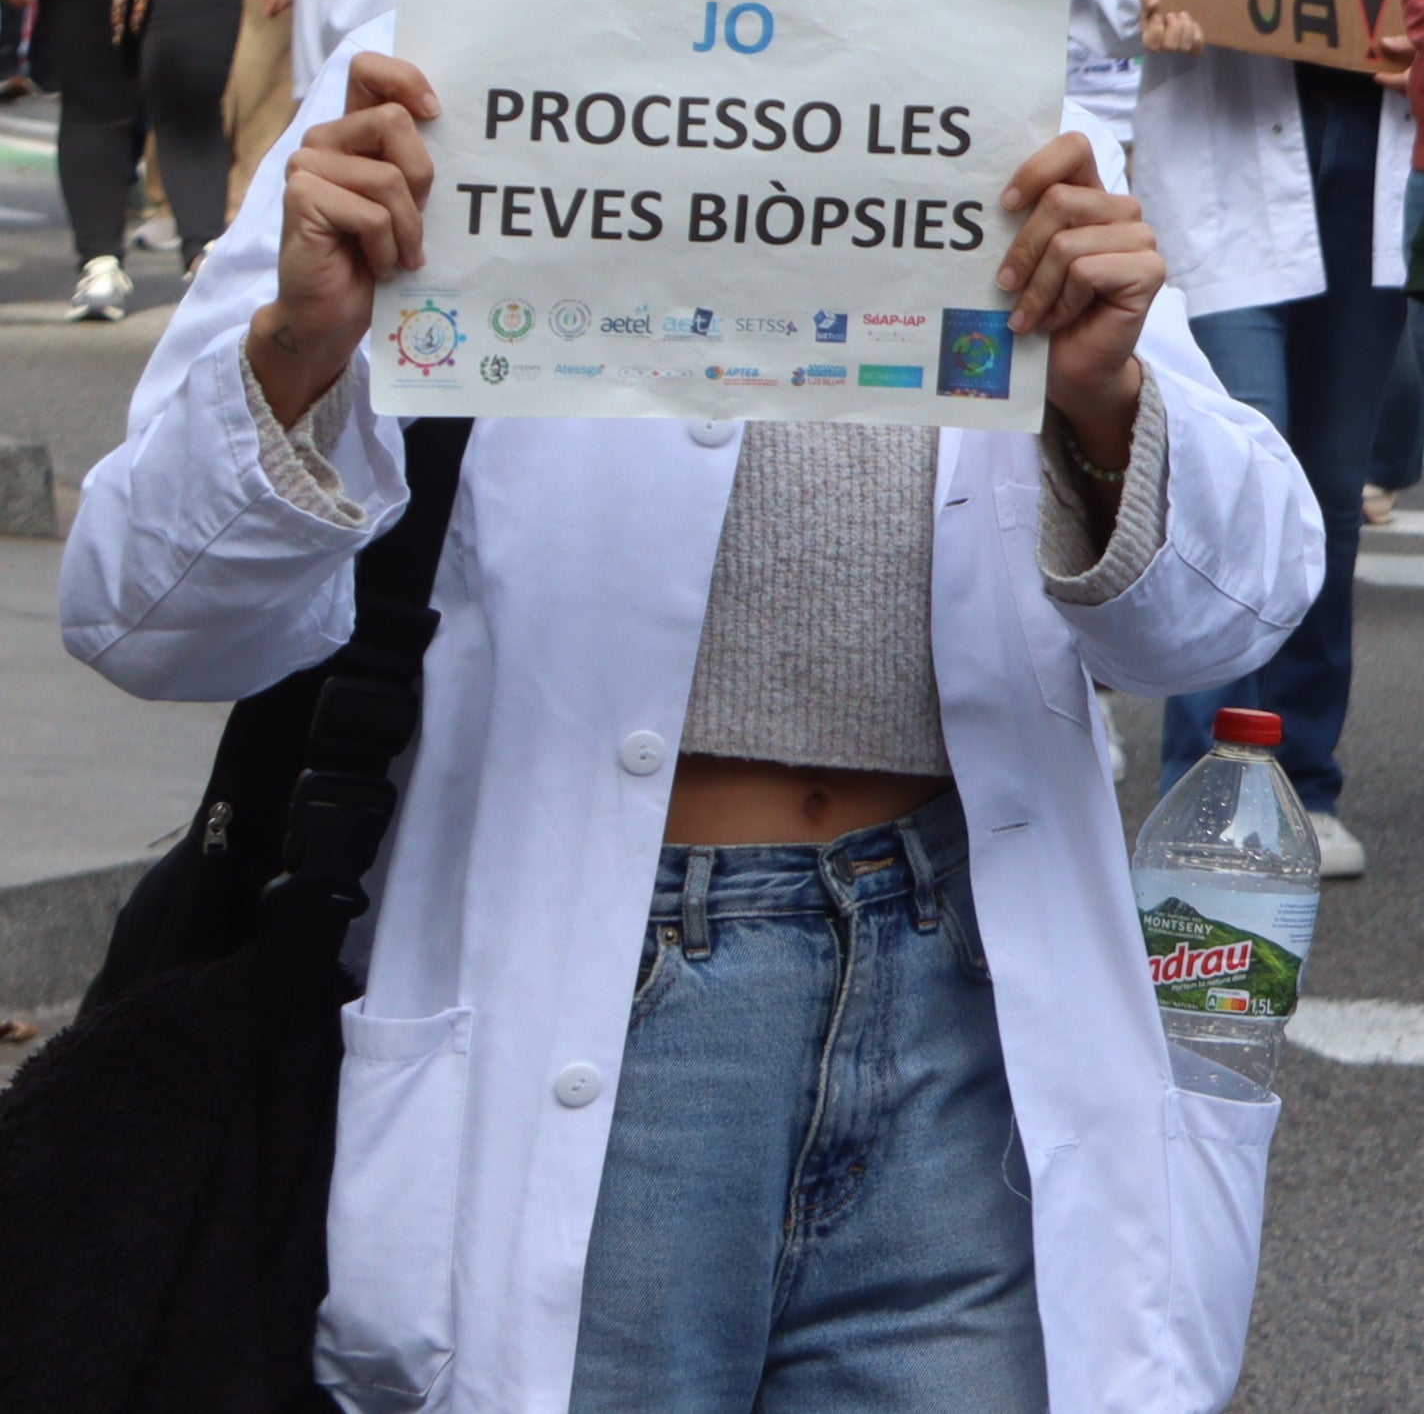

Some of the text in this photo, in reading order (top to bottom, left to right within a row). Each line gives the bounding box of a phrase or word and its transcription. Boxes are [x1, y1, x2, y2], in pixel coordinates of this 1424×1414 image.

[693, 0, 773, 54] JO
[485, 89, 971, 158] PROCESSO LES
[457, 180, 984, 252] TEVES BIÒPSIES
[600, 314, 652, 334] aetel
[1143, 914, 1214, 935] MONTSENY
[1250, 997, 1275, 1016] 1,5L
